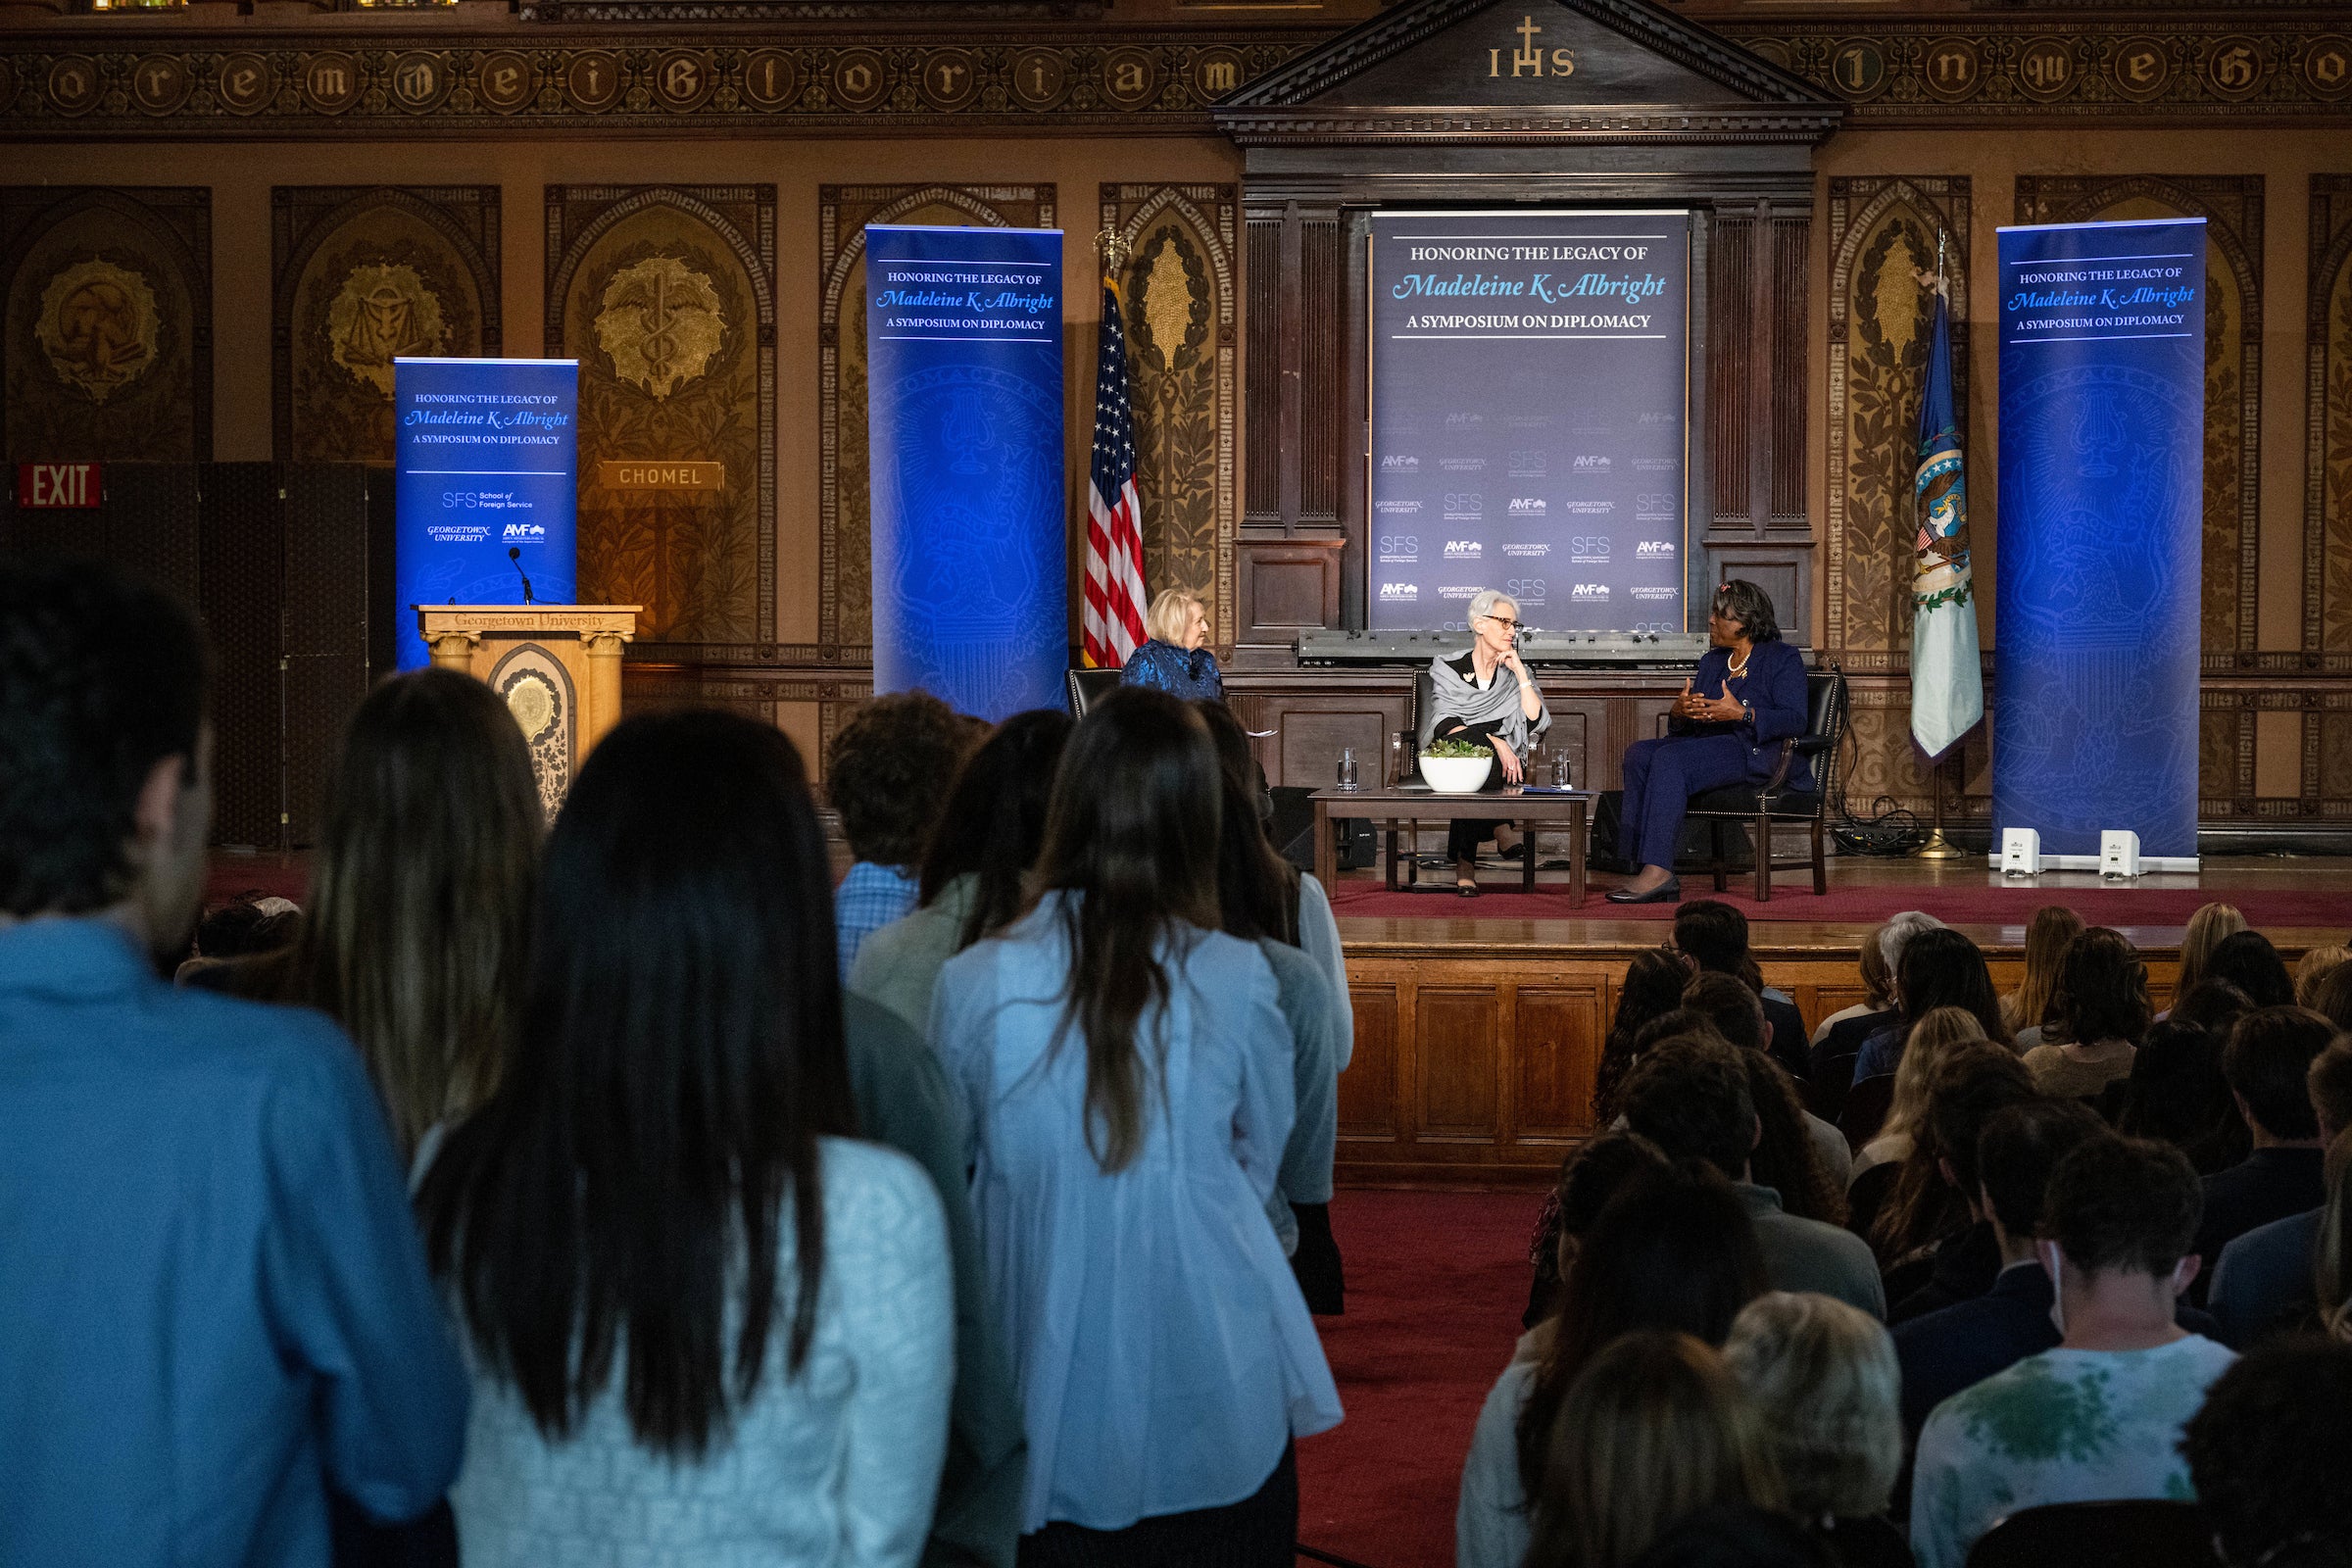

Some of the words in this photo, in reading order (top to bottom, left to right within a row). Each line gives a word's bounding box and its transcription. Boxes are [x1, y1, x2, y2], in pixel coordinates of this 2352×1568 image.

[1411, 247, 1509, 261] HONORING
[1512, 247, 1549, 261] THE
[1552, 246, 1621, 261] LEGACY
[1623, 246, 1648, 261] OF
[887, 271, 954, 283] HONORING
[955, 273, 979, 283] THE
[981, 274, 1025, 284] LEGACY
[1026, 274, 1043, 285] OF
[2020, 270, 2087, 284] HONORING
[2088, 270, 2115, 280] THE
[2116, 269, 2164, 279] LEGACY
[2165, 268, 2183, 277] OF
[1393, 273, 1523, 300] Madeleine
[1529, 273, 1556, 304] K.
[1557, 273, 1666, 304] Albright
[875, 290, 962, 308] Madeleine
[965, 292, 985, 313] K.
[984, 292, 1054, 314] Albright
[2008, 291, 2096, 312] Madeleine
[2099, 288, 2120, 310] K.
[2119, 286, 2195, 309] Albright
[886, 318, 894, 327] A
[896, 318, 960, 328] SYMPOSIUM
[961, 318, 979, 328] ON
[981, 319, 1045, 330] DIPLOMACY
[1406, 316, 1418, 328] A
[1421, 315, 1519, 328] SYMPOSIUM
[1522, 315, 1547, 328] ON
[1550, 315, 1651, 328] DIPLOMACY
[2017, 320, 2025, 330] A
[2026, 318, 2093, 329] SYMPOSIUM
[2094, 317, 2113, 326] ON
[2114, 315, 2184, 326] DIPLOMACY
[415, 394, 475, 404] HONORING
[476, 395, 499, 404] THE
[501, 395, 542, 405] LEGACY
[542, 395, 559, 405] OF
[404, 410, 484, 426] Madeleine
[486, 411, 504, 429] K.
[503, 411, 568, 430] Albright
[413, 434, 420, 444] A
[421, 434, 481, 444] SYMPOSIUM
[482, 435, 499, 444] ON
[500, 435, 560, 445] DIPLOMACY
[1382, 456, 1406, 466] AMF
[1573, 456, 1598, 466] AMF
[619, 468, 702, 484] CHOMEL
[32, 465, 90, 506] EXIT
[442, 492, 477, 509] SFS
[505, 492, 514, 501] of
[1444, 493, 1482, 511] SFS
[1637, 493, 1675, 511] SFS
[1509, 499, 1534, 510] AMF
[426, 525, 491, 536] GEORGETOWN
[503, 523, 530, 536] AMF
[1380, 535, 1418, 554] SFS
[1444, 541, 1469, 552] AMF
[1571, 536, 1610, 554] SFS
[1637, 541, 1662, 553] AMF
[1380, 583, 1405, 595] AMF
[1507, 579, 1545, 597] SFS
[1572, 584, 1597, 595] AMF
[455, 613, 534, 629] Georgetown
[539, 613, 606, 628] University
